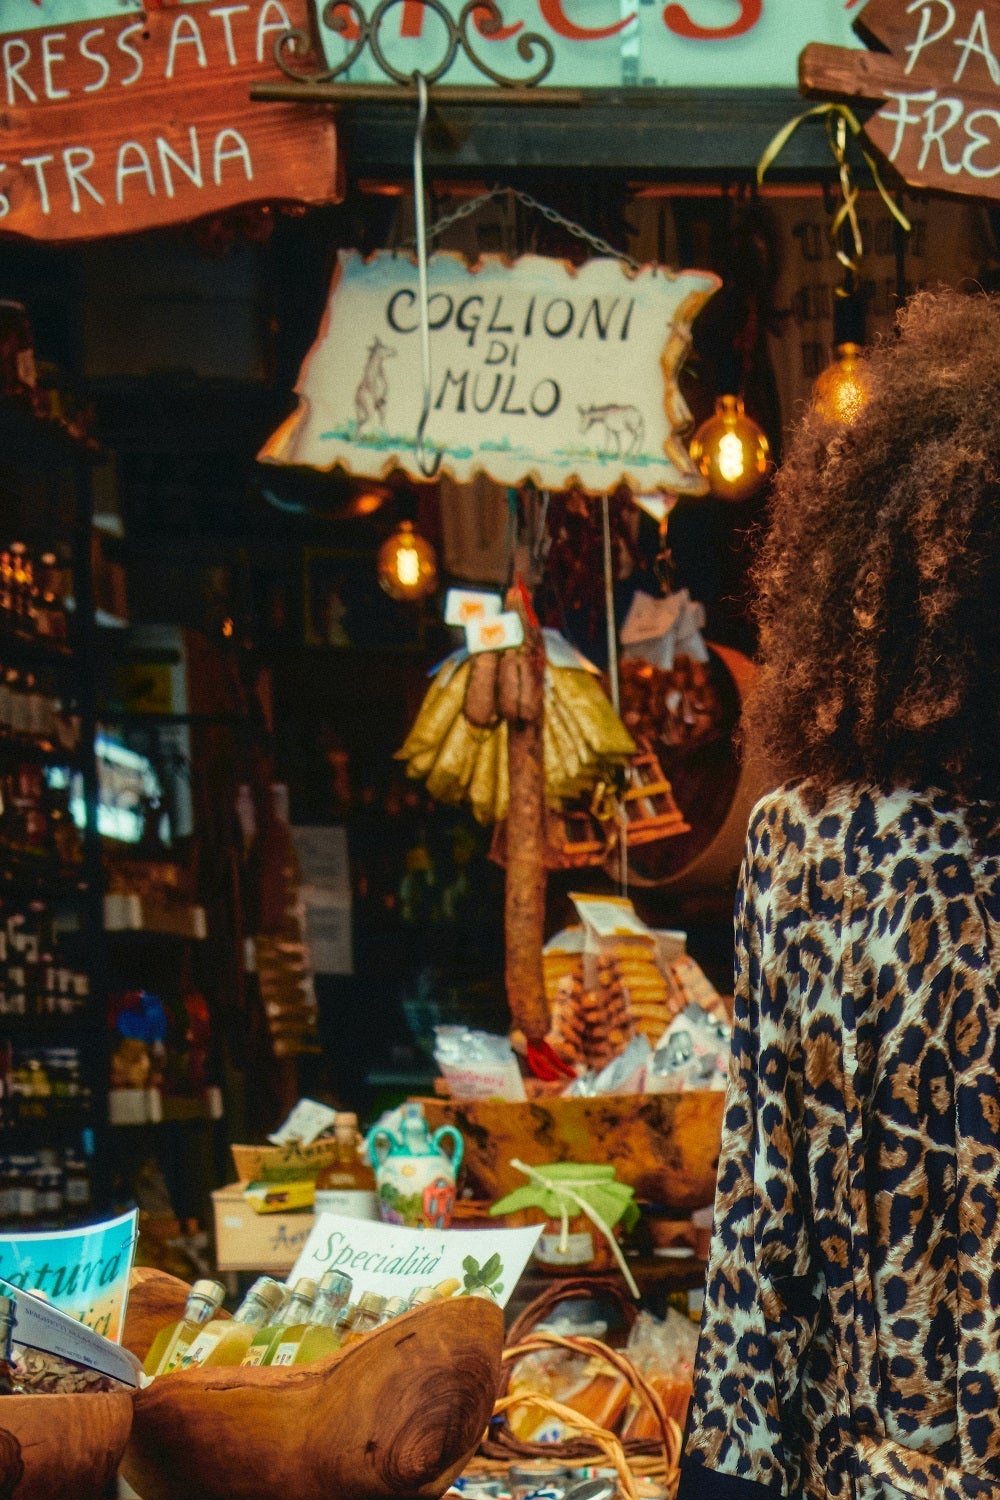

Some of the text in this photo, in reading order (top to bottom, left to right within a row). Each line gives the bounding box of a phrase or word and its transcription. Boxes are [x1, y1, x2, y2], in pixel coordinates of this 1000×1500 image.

[386, 288, 635, 346] COGLIONI
[484, 340, 518, 367] DI
[434, 367, 563, 419] MULO
[0, 1251, 122, 1297] atura
